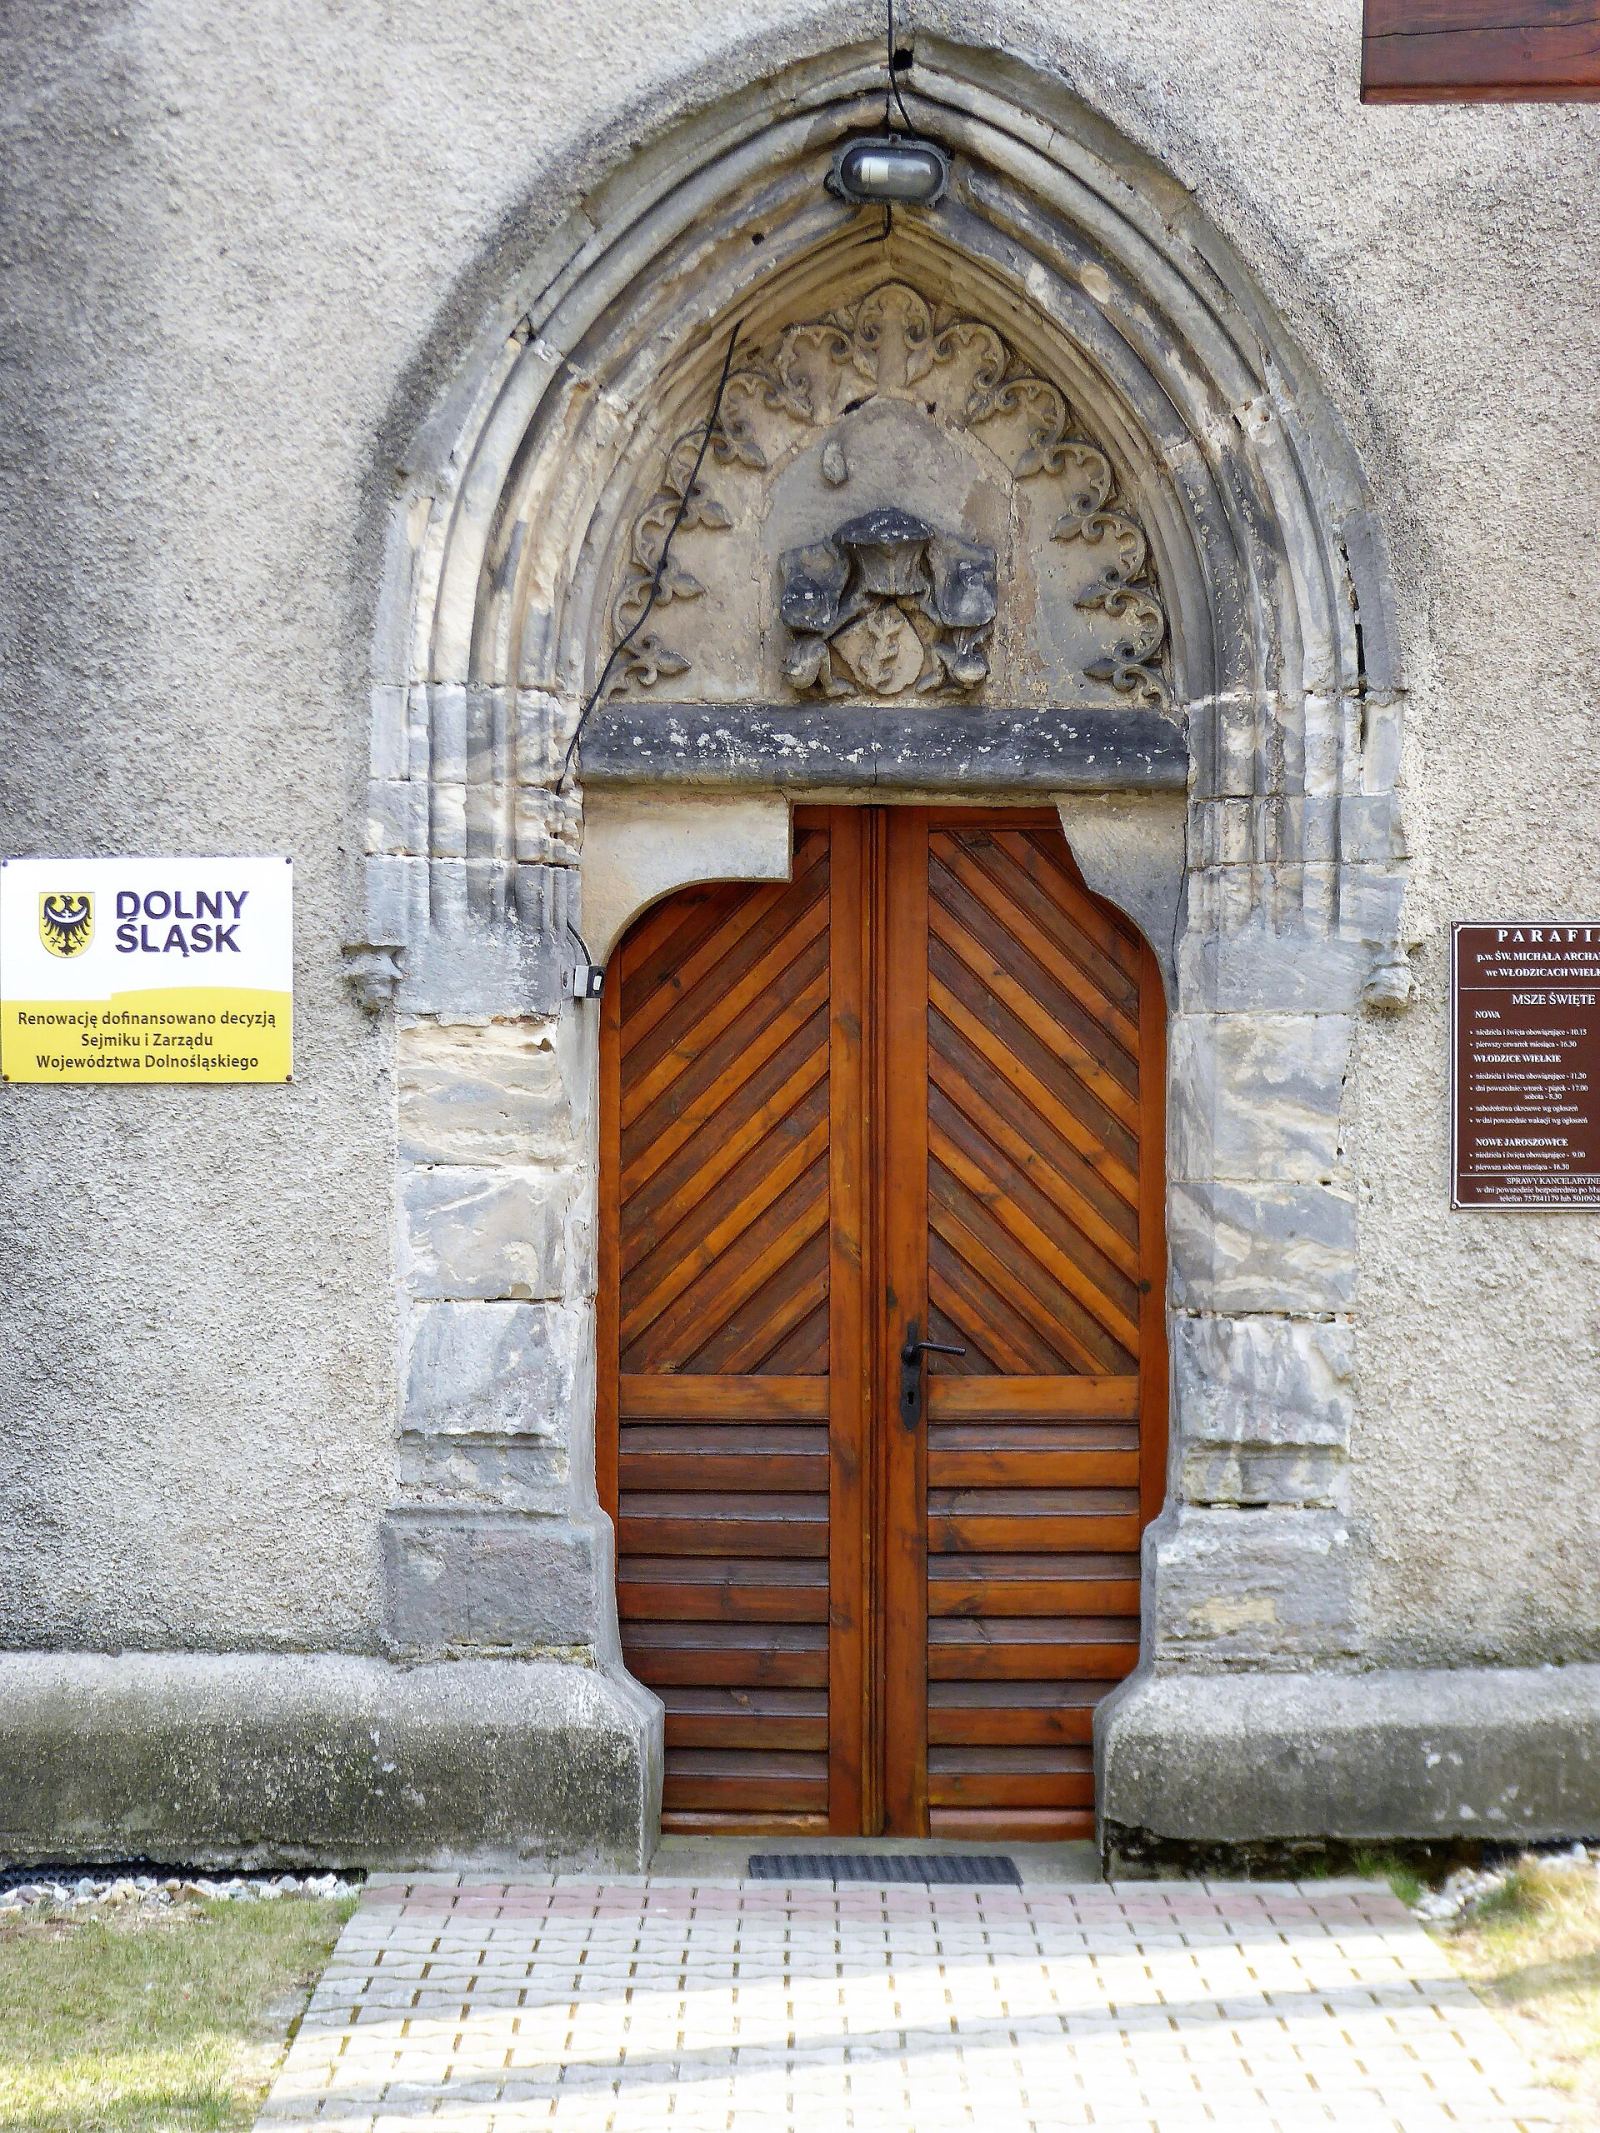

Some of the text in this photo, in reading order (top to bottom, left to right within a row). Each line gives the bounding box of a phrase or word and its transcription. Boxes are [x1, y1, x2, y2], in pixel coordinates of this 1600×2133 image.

[116, 891, 250, 920] DOLNY
[115, 917, 242, 957] ŚLĄSK
[1497, 929, 1600, 942] PARAFI
[1495, 950, 1512, 960] ŚW.
[1564, 952, 1600, 960] ARCHA
[1498, 968, 1568, 976] WŁODZICACH
[1512, 992, 1596, 1006] MSZE ŚWIĘTE
[18, 1011, 276, 1028] Renowację dofinansowano decyzją
[1475, 1010, 1501, 1018] NOWA
[81, 1033, 213, 1049] Sejmiku i Zarządu
[36, 1055, 259, 1071] Województwa Dolnośląskiego
[1473, 1054, 1562, 1062] WŁODZICE WIELKIE
[1476, 1138, 1568, 1146] NOWE JAROSZOWICE
